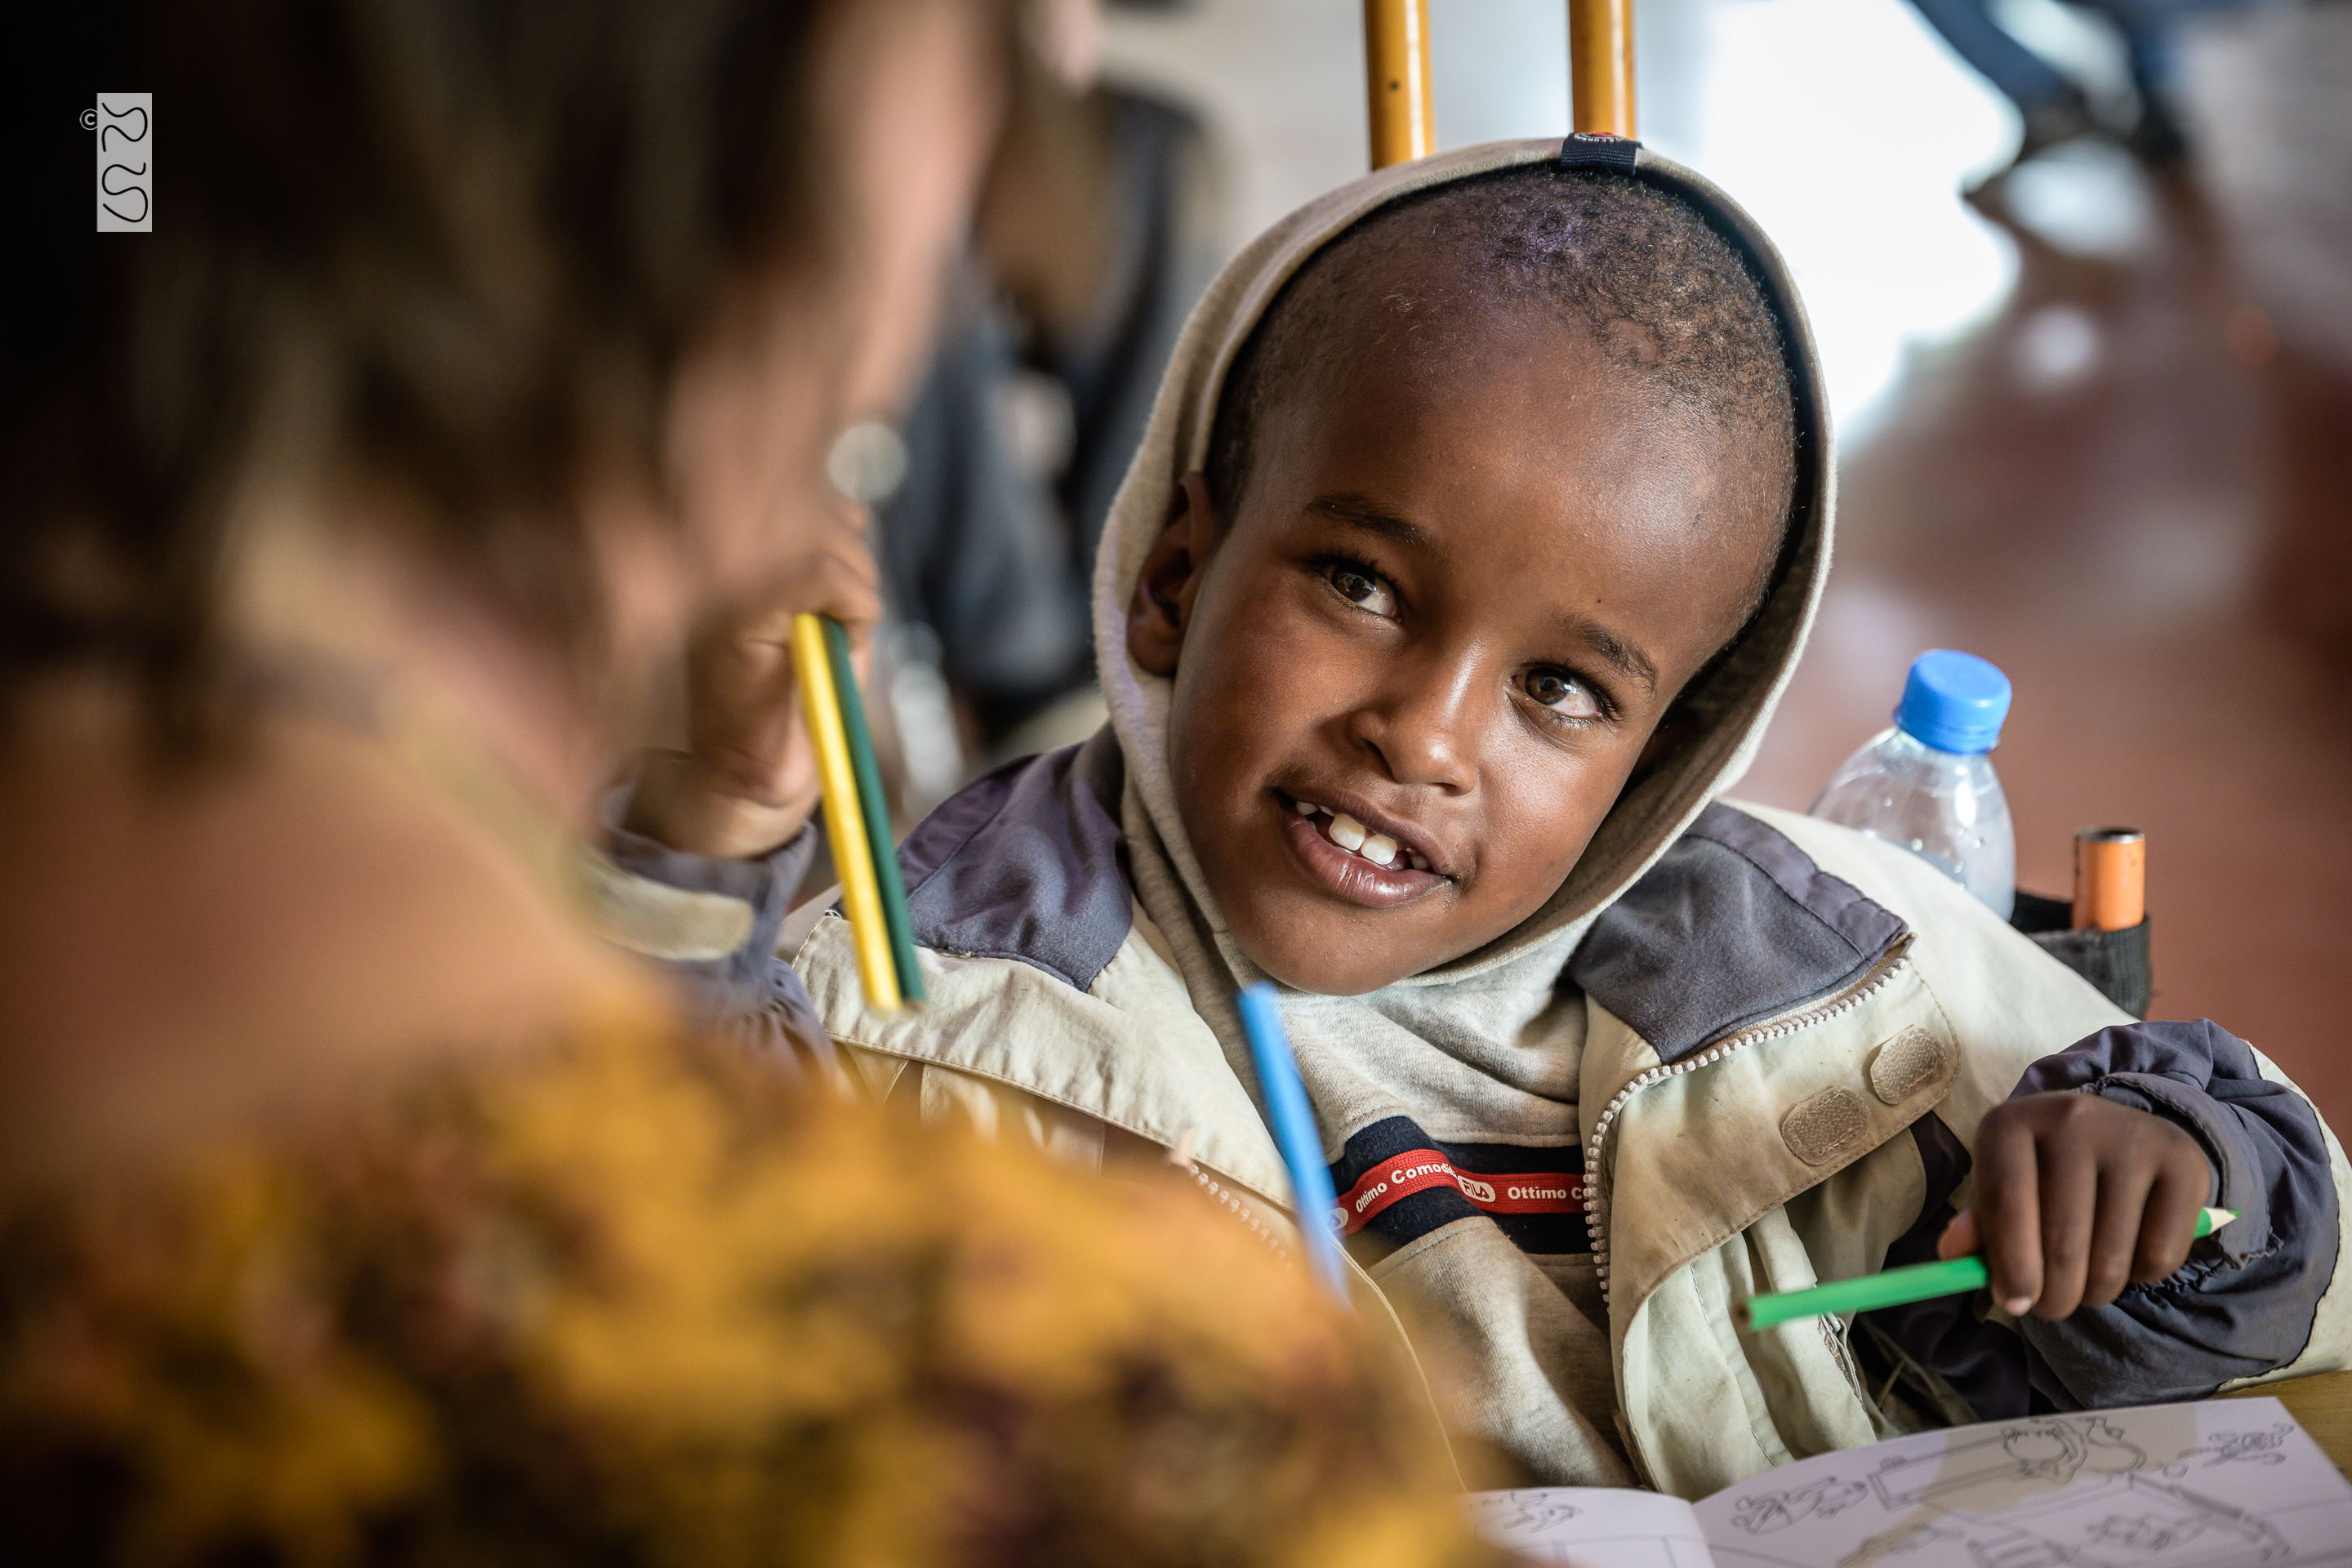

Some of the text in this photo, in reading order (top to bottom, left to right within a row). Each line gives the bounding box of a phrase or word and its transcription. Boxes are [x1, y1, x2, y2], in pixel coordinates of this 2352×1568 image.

[1356, 1183, 1388, 1214] Ottimo
[1461, 1180, 1490, 1200] FILA
[1507, 1186, 1567, 1200] Ottimo
